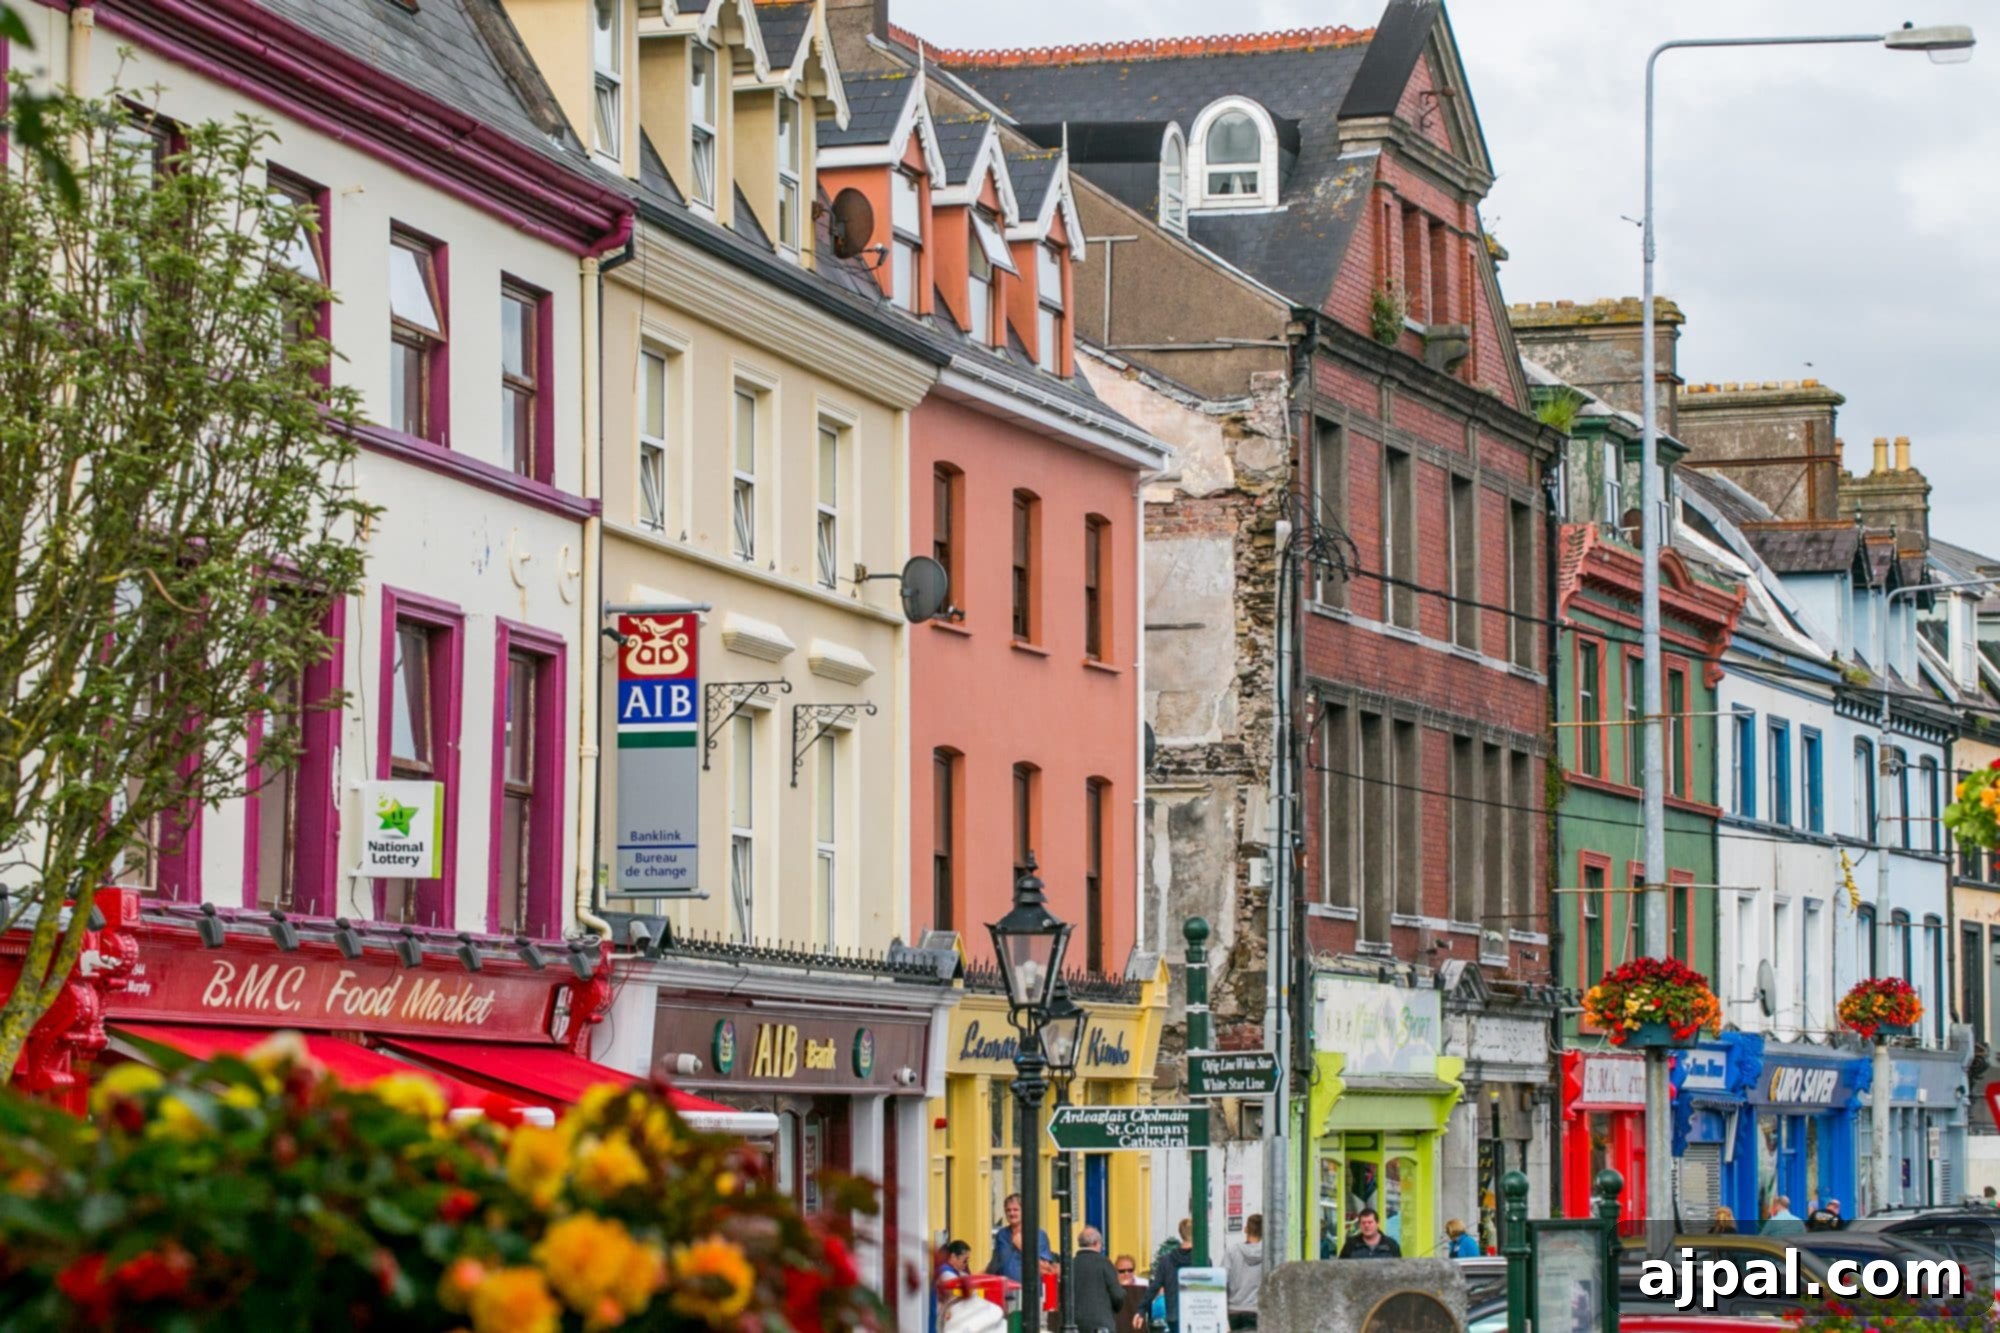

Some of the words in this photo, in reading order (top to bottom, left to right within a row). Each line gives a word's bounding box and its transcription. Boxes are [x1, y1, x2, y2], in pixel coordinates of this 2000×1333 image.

[623, 684, 692, 718] AIB
[630, 830, 681, 842] Banklink
[368, 841, 424, 852] National
[372, 853, 420, 868] Lottery
[635, 852, 677, 863] Bureau
[625, 866, 641, 877] de
[644, 866, 687, 880] change
[202, 960, 305, 1011] B.M.C.
[325, 970, 403, 1017] Food
[401, 977, 495, 1025] Market
[751, 1023, 798, 1078] AIB
[804, 1037, 837, 1070] Bank
[1086, 1027, 1130, 1067] Kimbo
[1236, 1057, 1256, 1070] White
[1257, 1056, 1273, 1070] Star
[1202, 1078, 1227, 1091] White
[1228, 1077, 1245, 1090] Star
[1245, 1076, 1265, 1090] Line
[1800, 1068, 1839, 1103] SAVER
[1060, 1110, 1127, 1125] Ardeaglais
[1119, 1136, 1189, 1148] Cathedral
